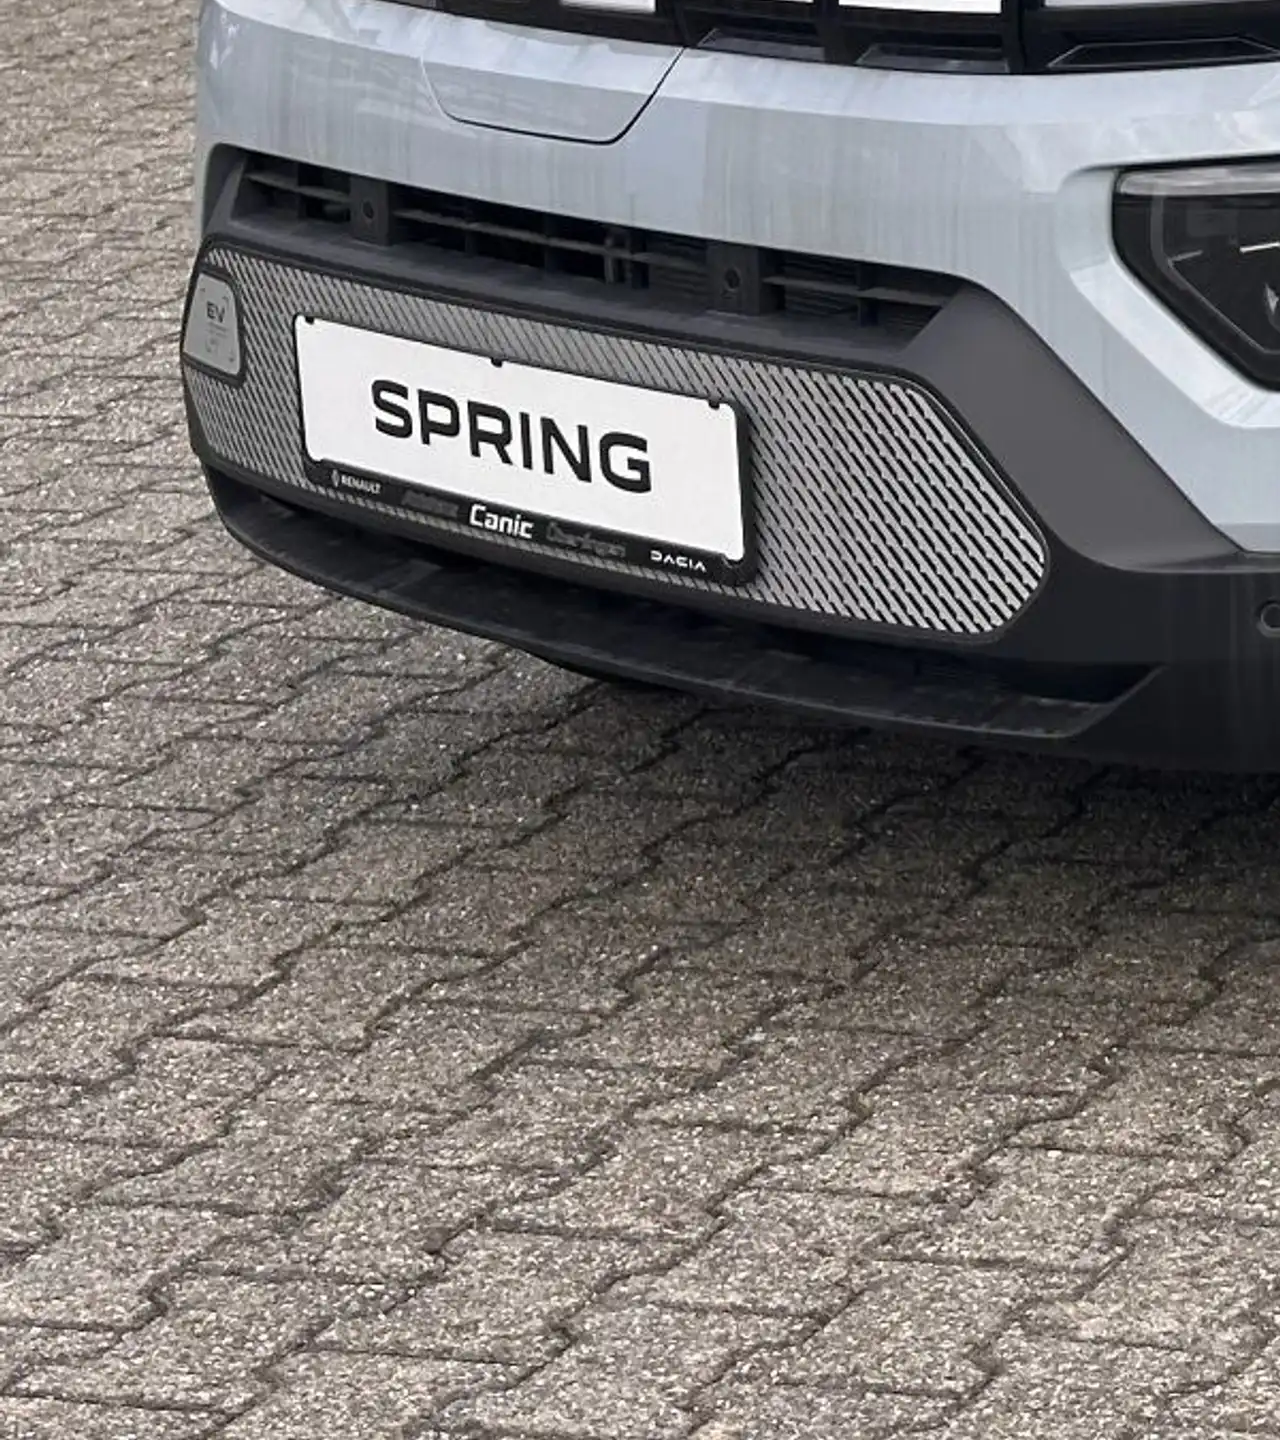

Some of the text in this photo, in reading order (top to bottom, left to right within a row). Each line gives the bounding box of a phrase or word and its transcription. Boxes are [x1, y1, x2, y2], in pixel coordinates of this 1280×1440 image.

[373, 380, 651, 494] SPRING
[468, 503, 535, 540] Canic
[650, 549, 708, 572] DACIA
